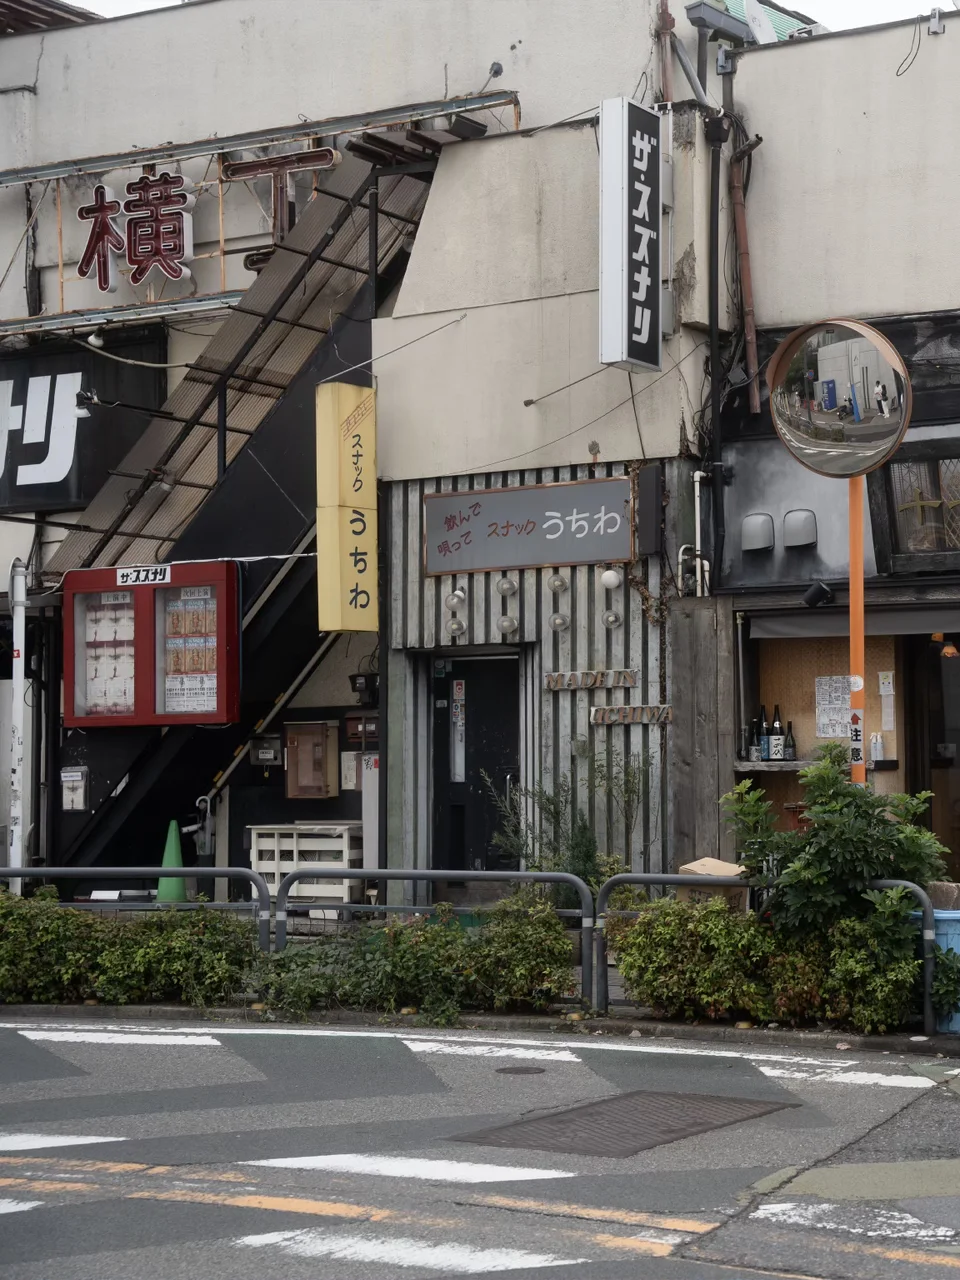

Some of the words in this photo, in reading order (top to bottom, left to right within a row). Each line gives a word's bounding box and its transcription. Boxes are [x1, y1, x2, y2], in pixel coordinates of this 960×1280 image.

[632, 129, 657, 344] ザ・スズナリ
[352, 433, 363, 493] スナック
[443, 502, 482, 532] 飲んで
[487, 518, 536, 537] スナック
[542, 505, 621, 539] うちわ
[349, 509, 370, 609] うちわ
[437, 531, 472, 557] 唄って
[545, 671, 607, 689] MADE
[612, 670, 638, 687] IN
[850, 727, 862, 761] 注意
